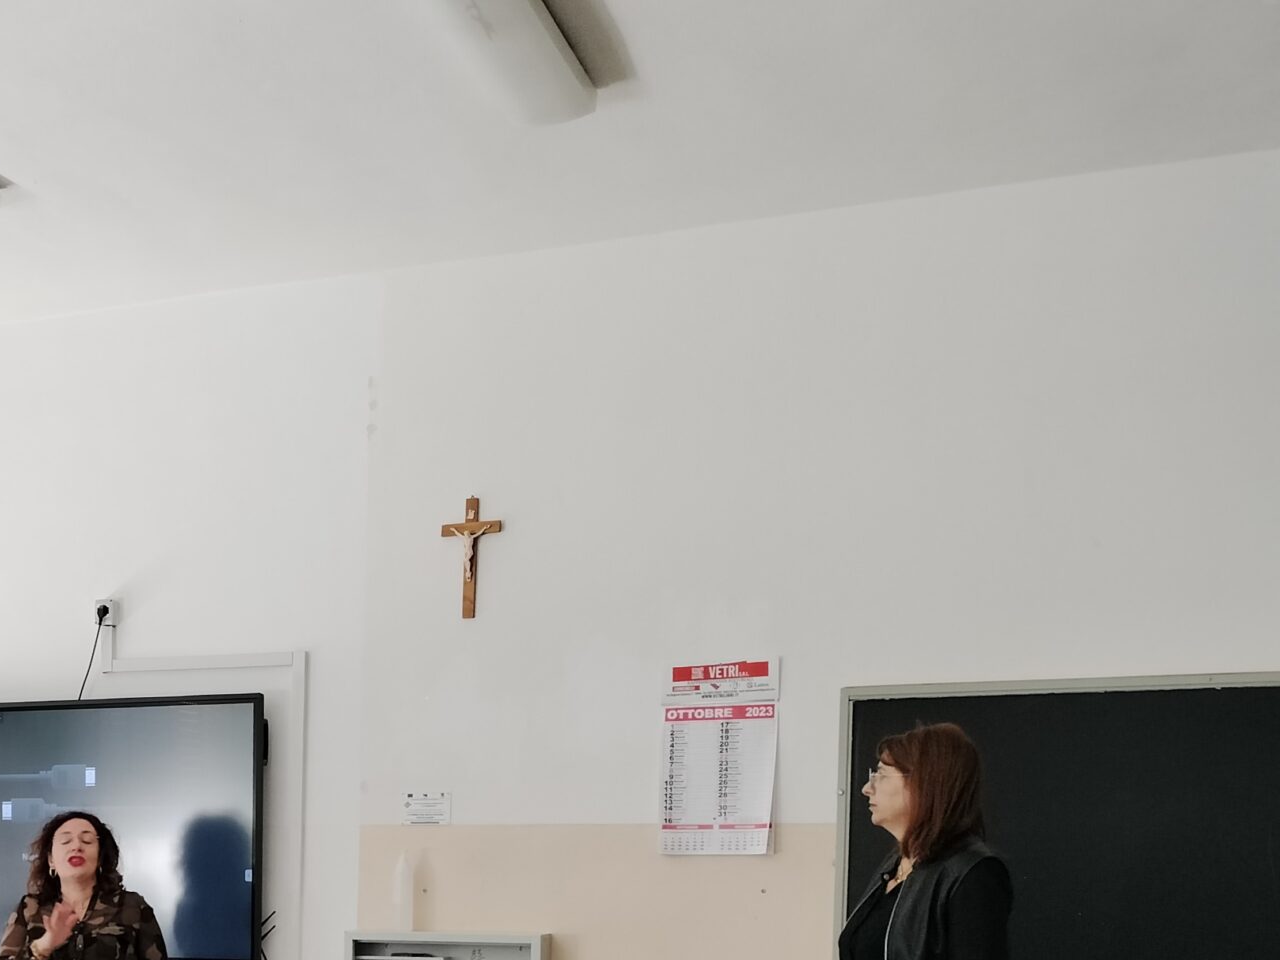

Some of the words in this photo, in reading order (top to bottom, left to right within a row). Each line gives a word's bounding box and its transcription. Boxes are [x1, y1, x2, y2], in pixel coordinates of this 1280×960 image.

[709, 664, 739, 679] VETRI
[666, 708, 733, 720] OTTOBRE
[745, 706, 774, 718] 2023
